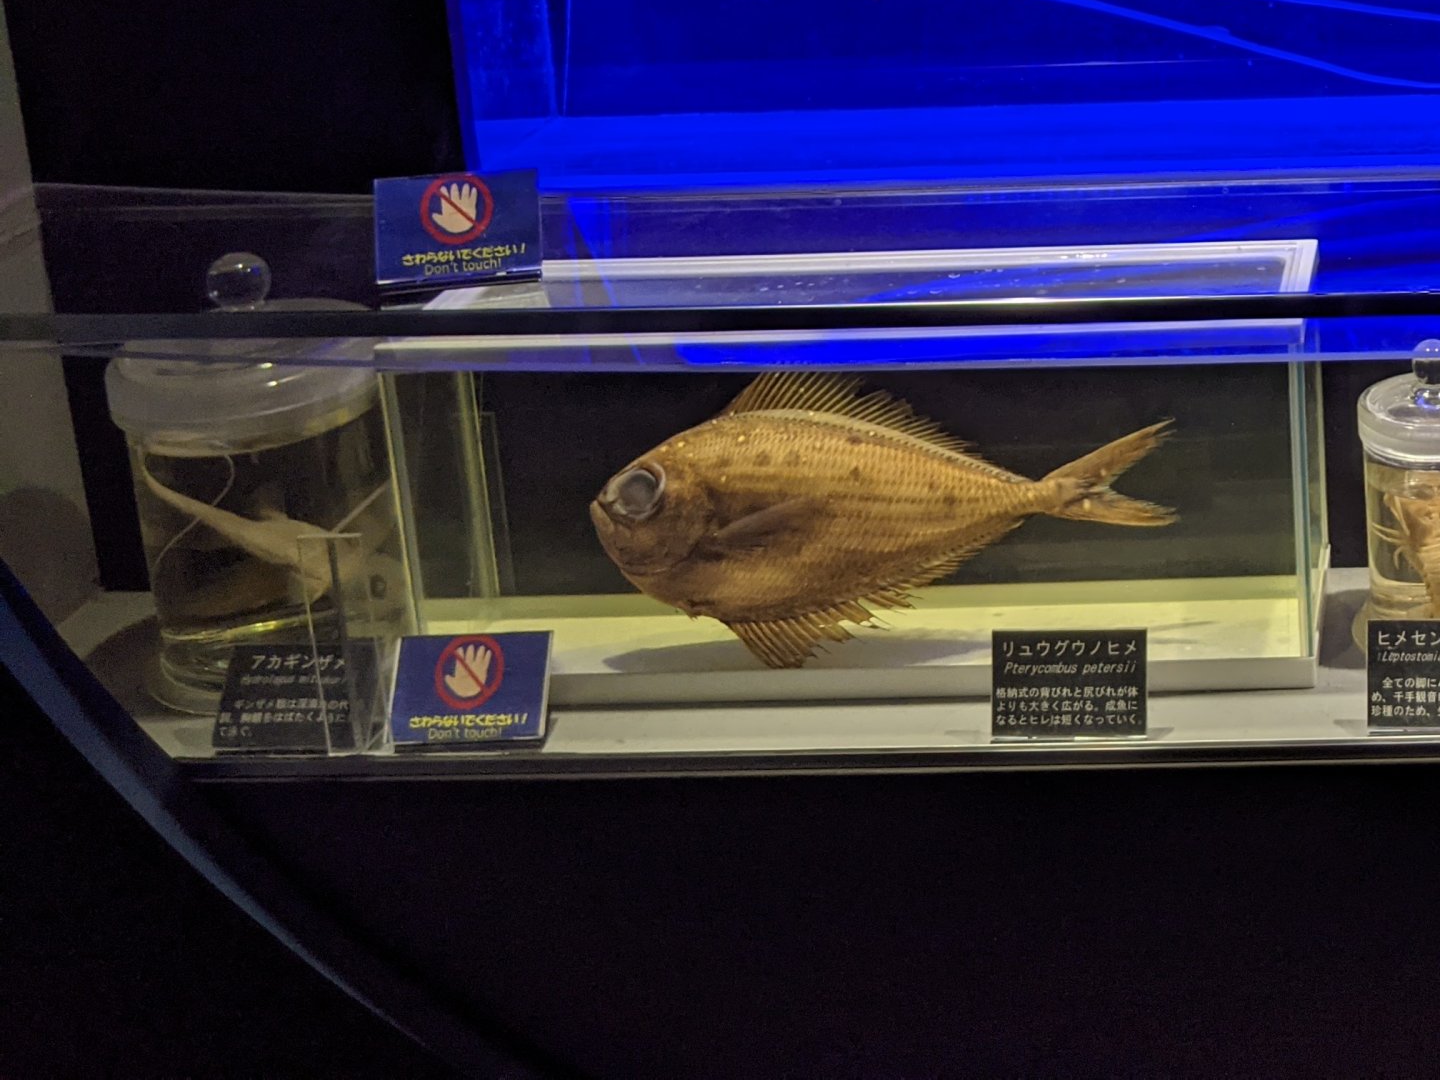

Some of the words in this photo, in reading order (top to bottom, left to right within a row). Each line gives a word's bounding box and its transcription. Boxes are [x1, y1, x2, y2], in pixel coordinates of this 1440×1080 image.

[424, 262, 458, 275] Don't
[462, 259, 502, 271] touch!
[1003, 640, 1137, 657] リュウグウノヒメ
[428, 728, 460, 739] Don't
